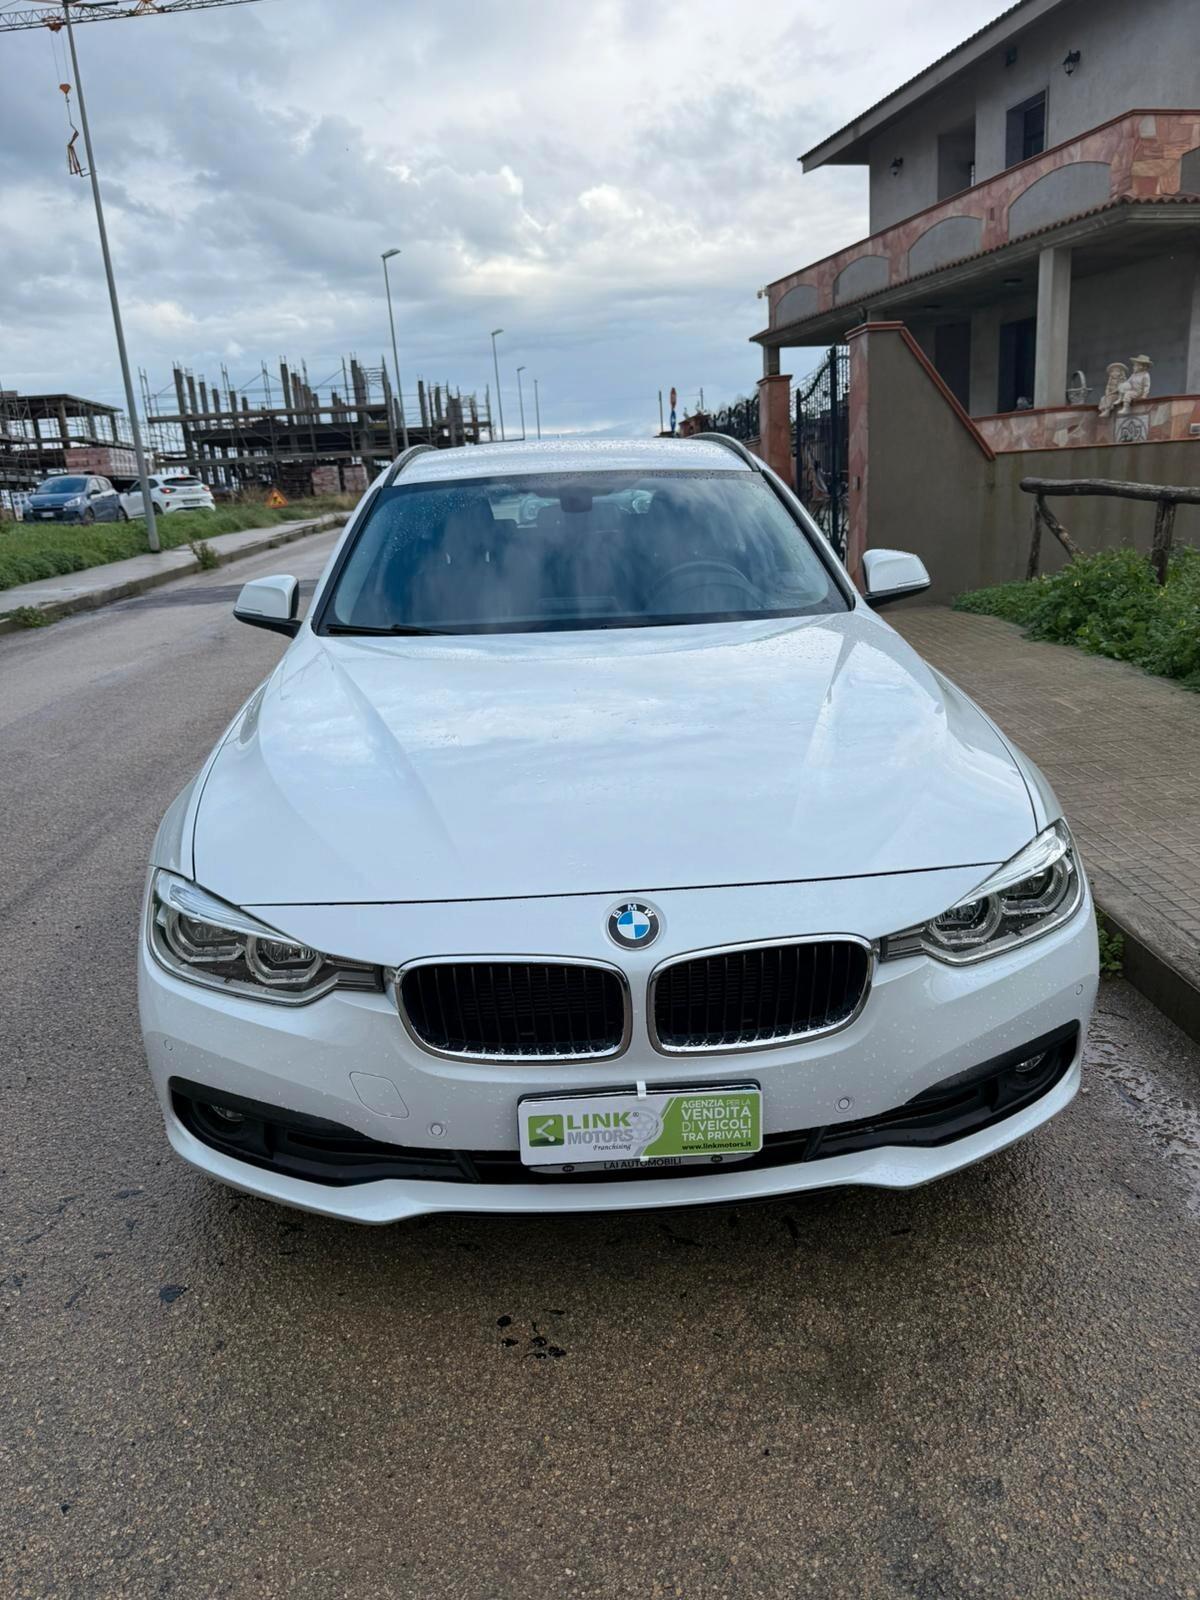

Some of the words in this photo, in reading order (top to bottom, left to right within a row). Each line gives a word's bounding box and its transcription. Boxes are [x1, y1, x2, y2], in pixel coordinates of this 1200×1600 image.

[612, 904, 655, 918] BMW
[681, 1099, 725, 1109] AGENZIA
[681, 1106, 752, 1121] VENDITA
[566, 1111, 632, 1130] LINK
[682, 1121, 695, 1133] DI
[697, 1118, 752, 1132] VEICOLI
[567, 1128, 634, 1145] MOTORS
[681, 1132, 704, 1141] TRA
[707, 1129, 751, 1141] PRIVATI
[592, 1143, 632, 1152] Franchising
[681, 1141, 752, 1150] www.linkmotors.it
[621, 1157, 682, 1168] AUTOMOBILI
